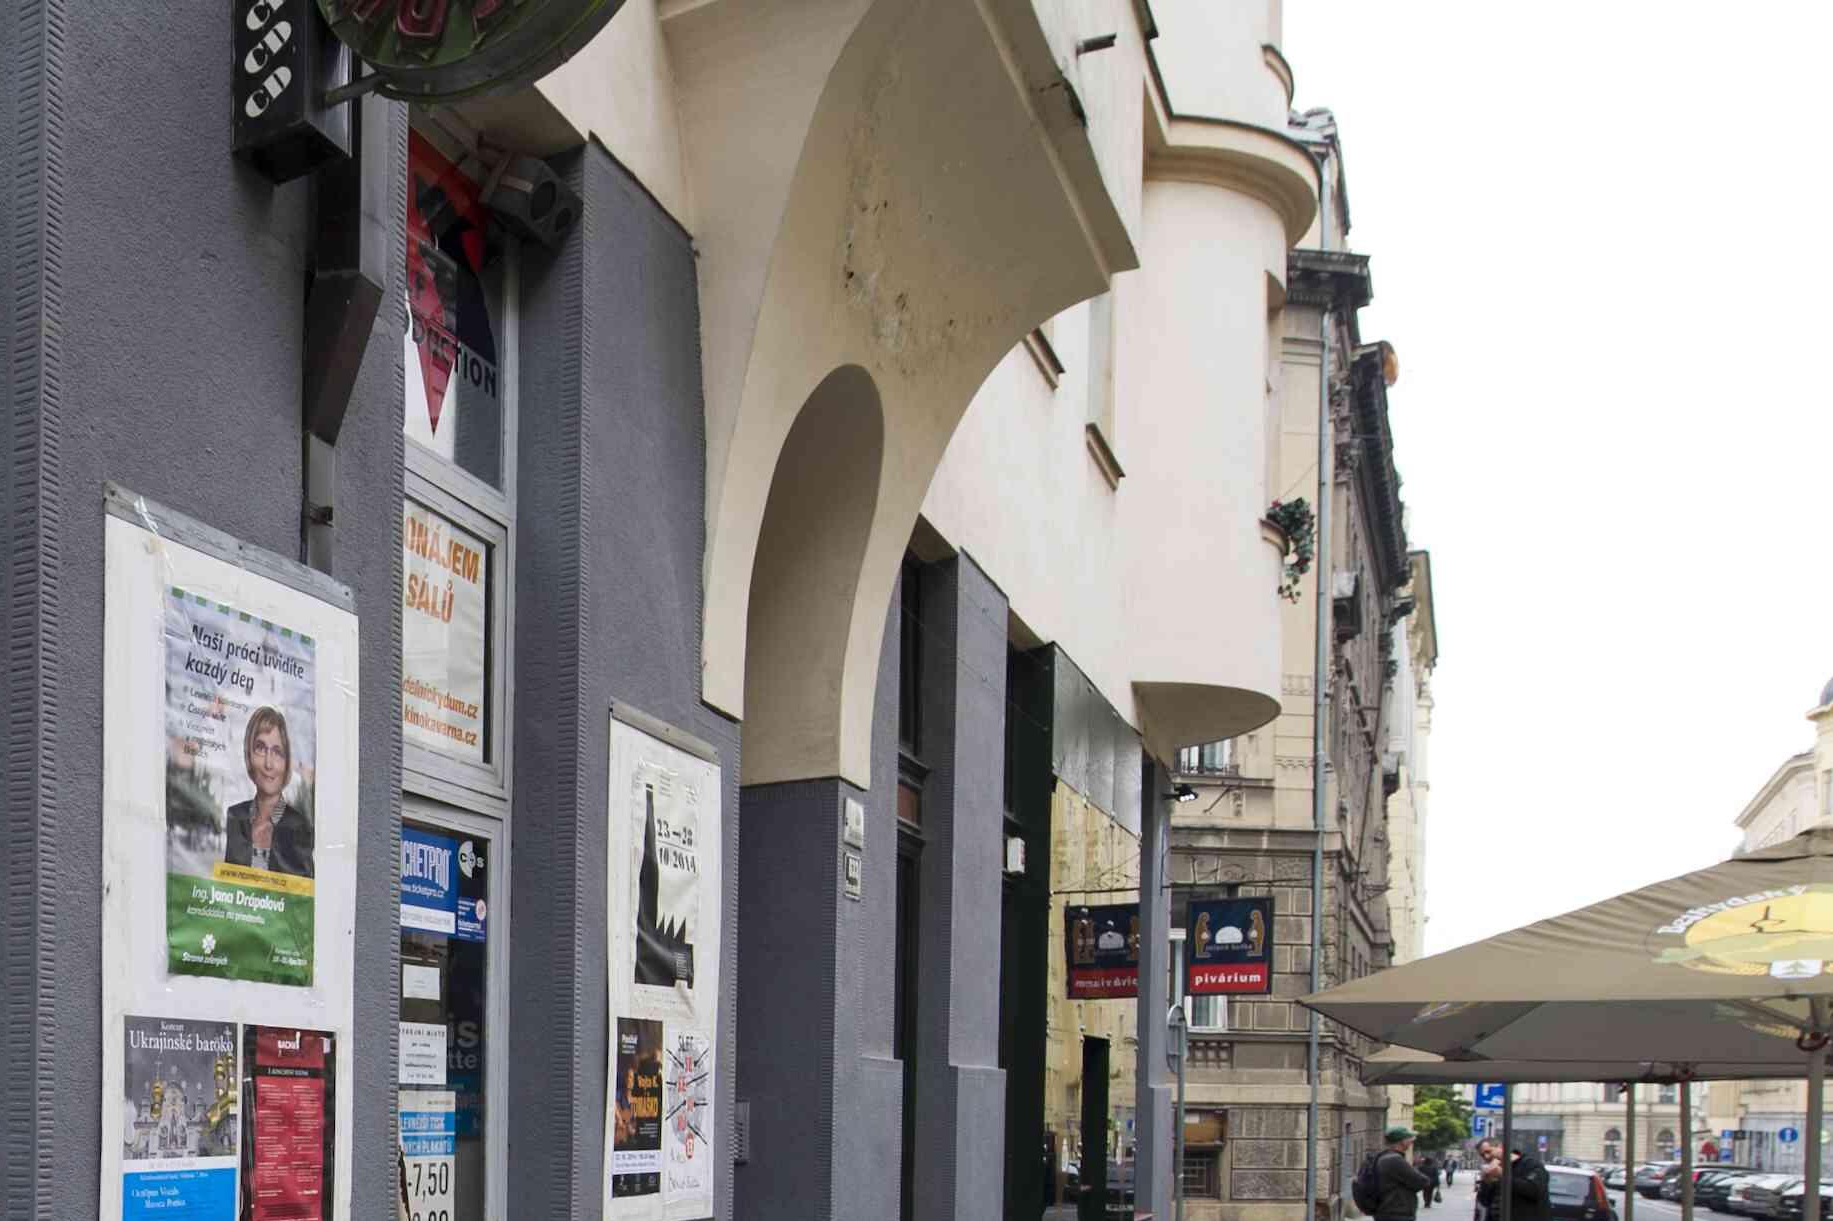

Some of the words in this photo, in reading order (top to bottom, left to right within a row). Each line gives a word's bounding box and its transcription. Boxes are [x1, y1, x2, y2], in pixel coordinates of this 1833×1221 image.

[244, 21, 292, 73] CD
[245, 66, 292, 117] CD
[406, 573, 455, 624] SÁLŮ
[185, 652, 227, 686] každý
[192, 624, 224, 652] Naši
[226, 641, 261, 666] práci
[264, 651, 304, 679] uvidíte
[209, 886, 233, 904] Jana
[236, 890, 285, 912] Drápalová
[1195, 973, 1262, 986] pivárium
[129, 1030, 192, 1054] Ukrajinské
[196, 1033, 234, 1052] baroko
